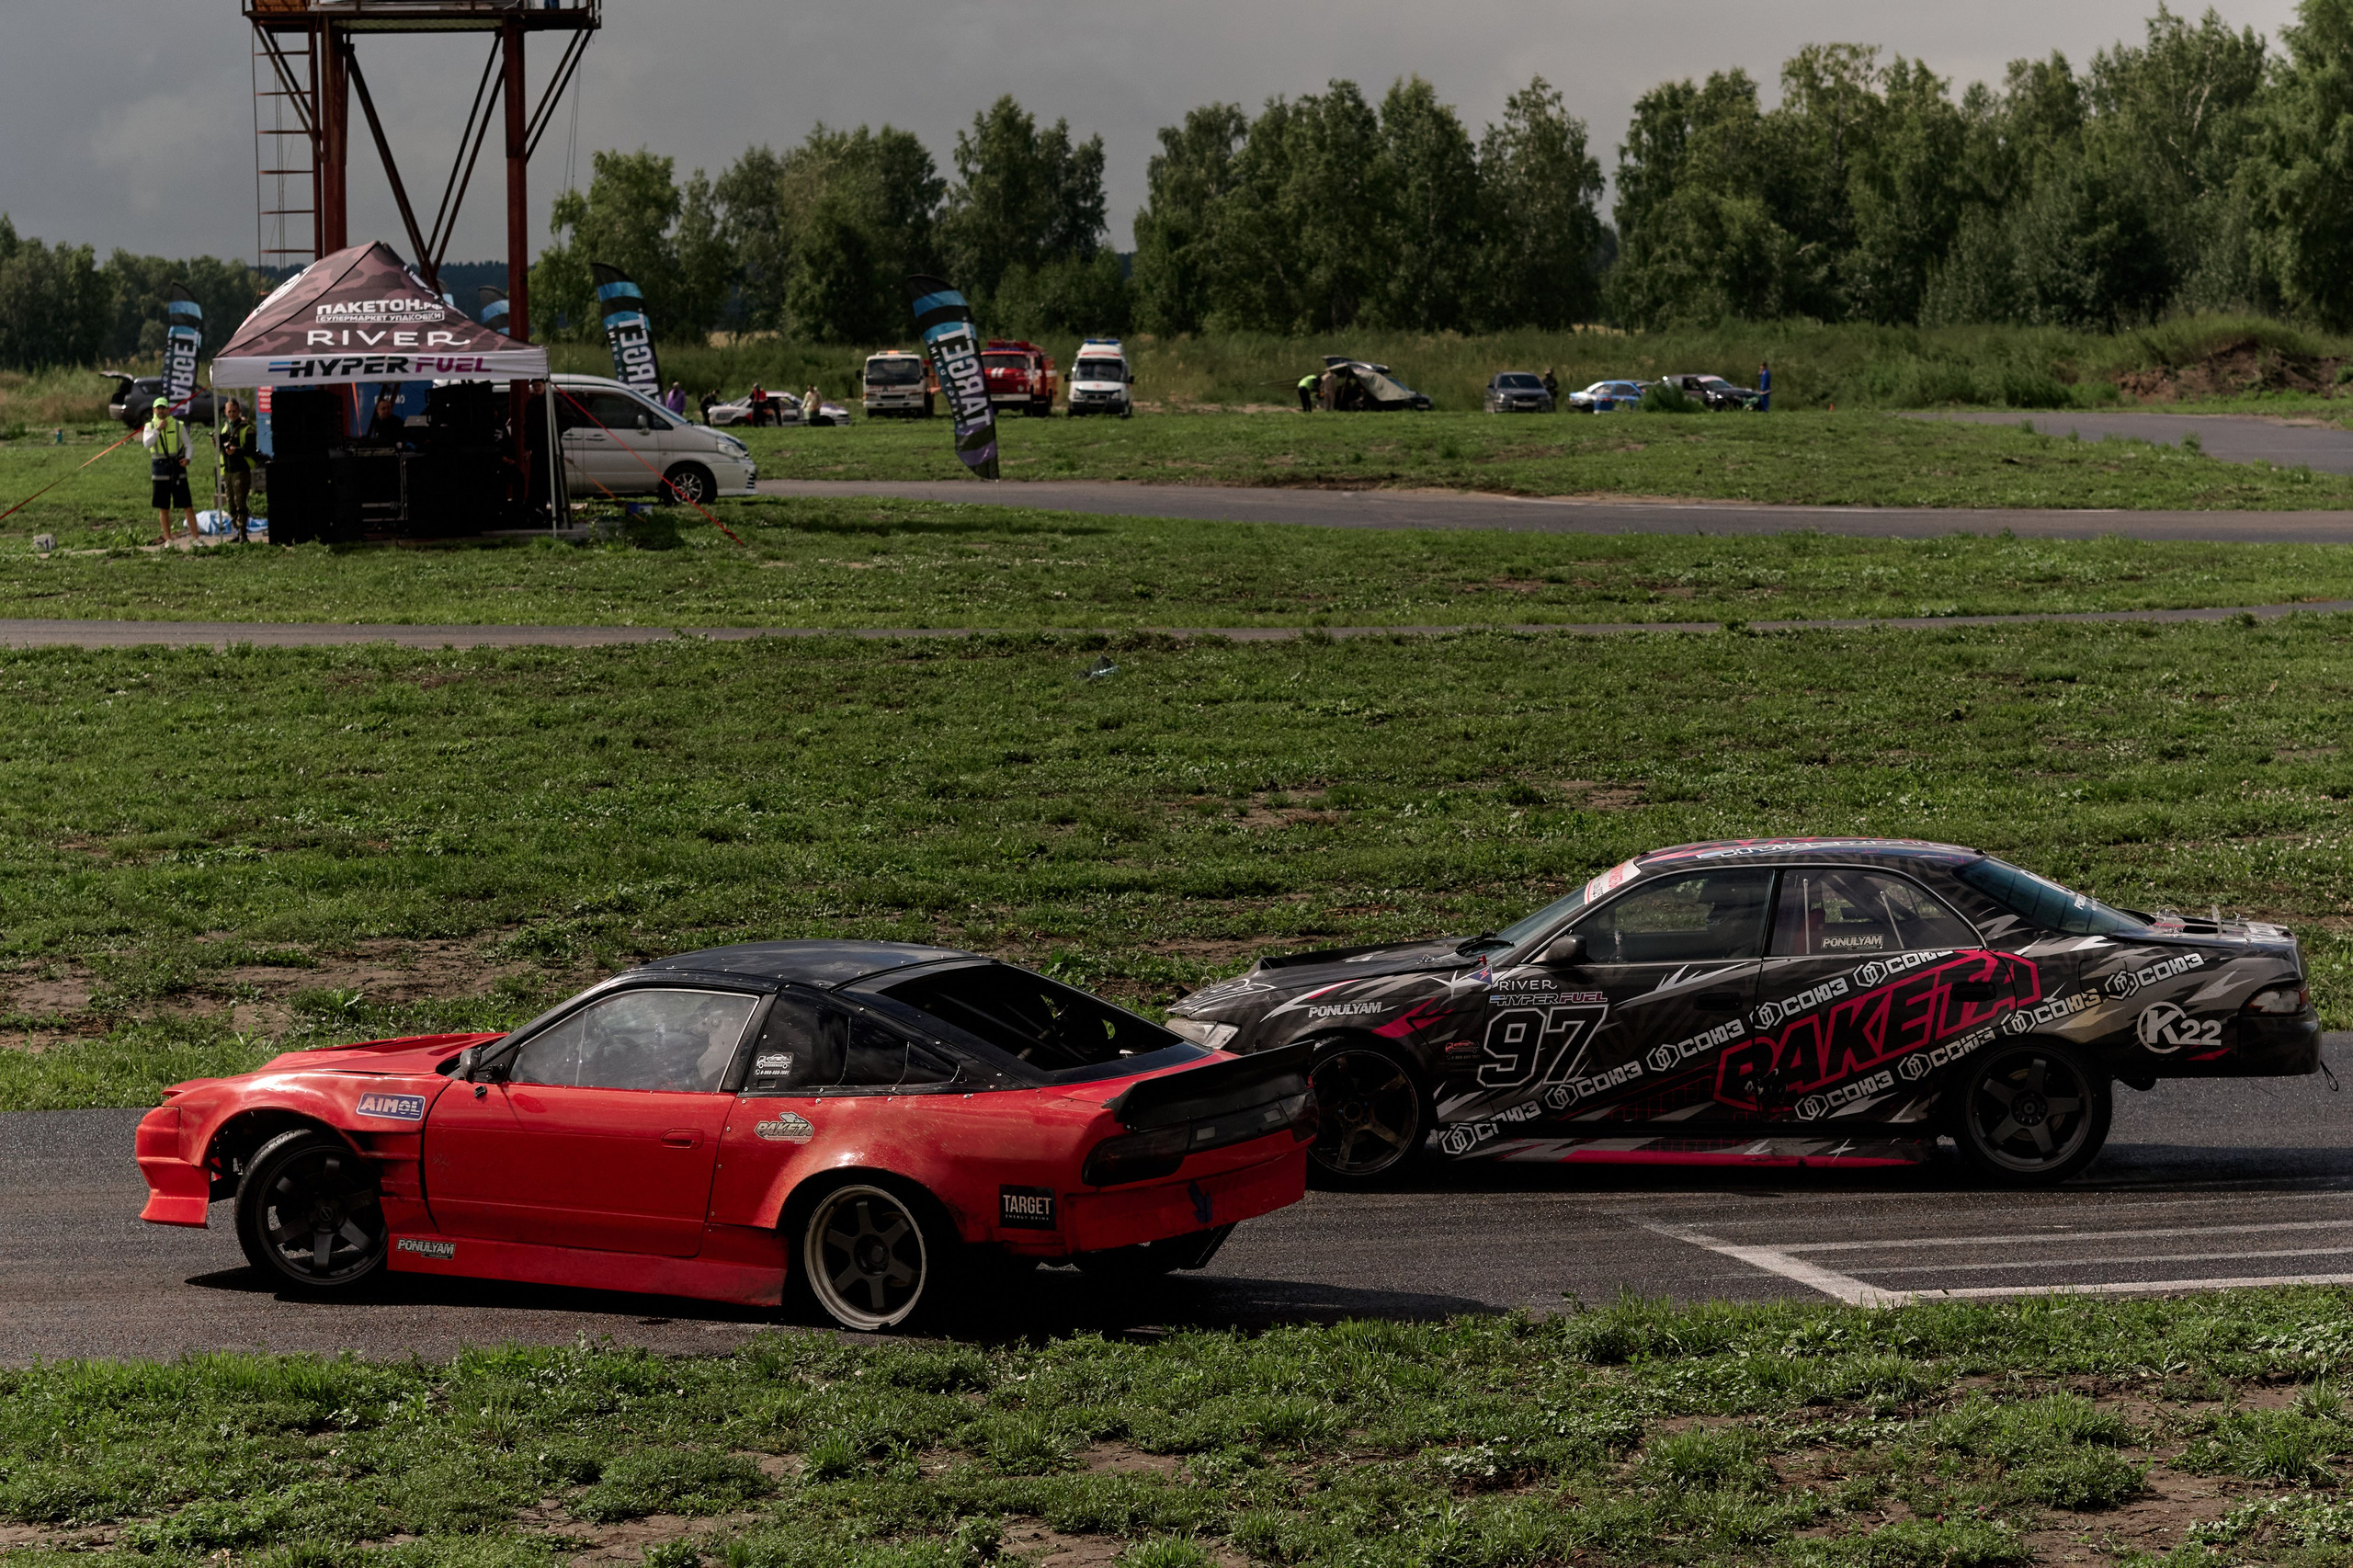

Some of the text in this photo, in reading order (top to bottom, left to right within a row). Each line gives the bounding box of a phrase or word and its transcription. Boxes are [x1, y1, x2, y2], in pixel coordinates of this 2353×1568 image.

[319, 312, 441, 323] СУПЕРМАРКЕТ УПАКОВКИ
[307, 330, 471, 347] RIVER
[270, 356, 493, 378] HYPER FUEL
[1823, 935, 1882, 948] PONULYAM
[2136, 952, 2205, 987] СОЮЗ
[1499, 980, 1558, 991] RIVER
[1490, 991, 1608, 1006] HYPER FUEL
[1781, 977, 1849, 1017] СОЮЗ
[2034, 987, 2102, 1024] СОЮЗ
[1308, 1001, 1382, 1018] PONULYAM
[2144, 1007, 2222, 1047] K22
[1477, 1004, 1609, 1087] 97
[1677, 1018, 1745, 1058] СОЮЗ
[1575, 1061, 1643, 1097] СОЮЗ
[1827, 1070, 1894, 1107] СОЮЗ
[359, 1096, 420, 1116] AIMOL
[1003, 1195, 1051, 1215] TARGET
[397, 1239, 455, 1255] PONULYAM
